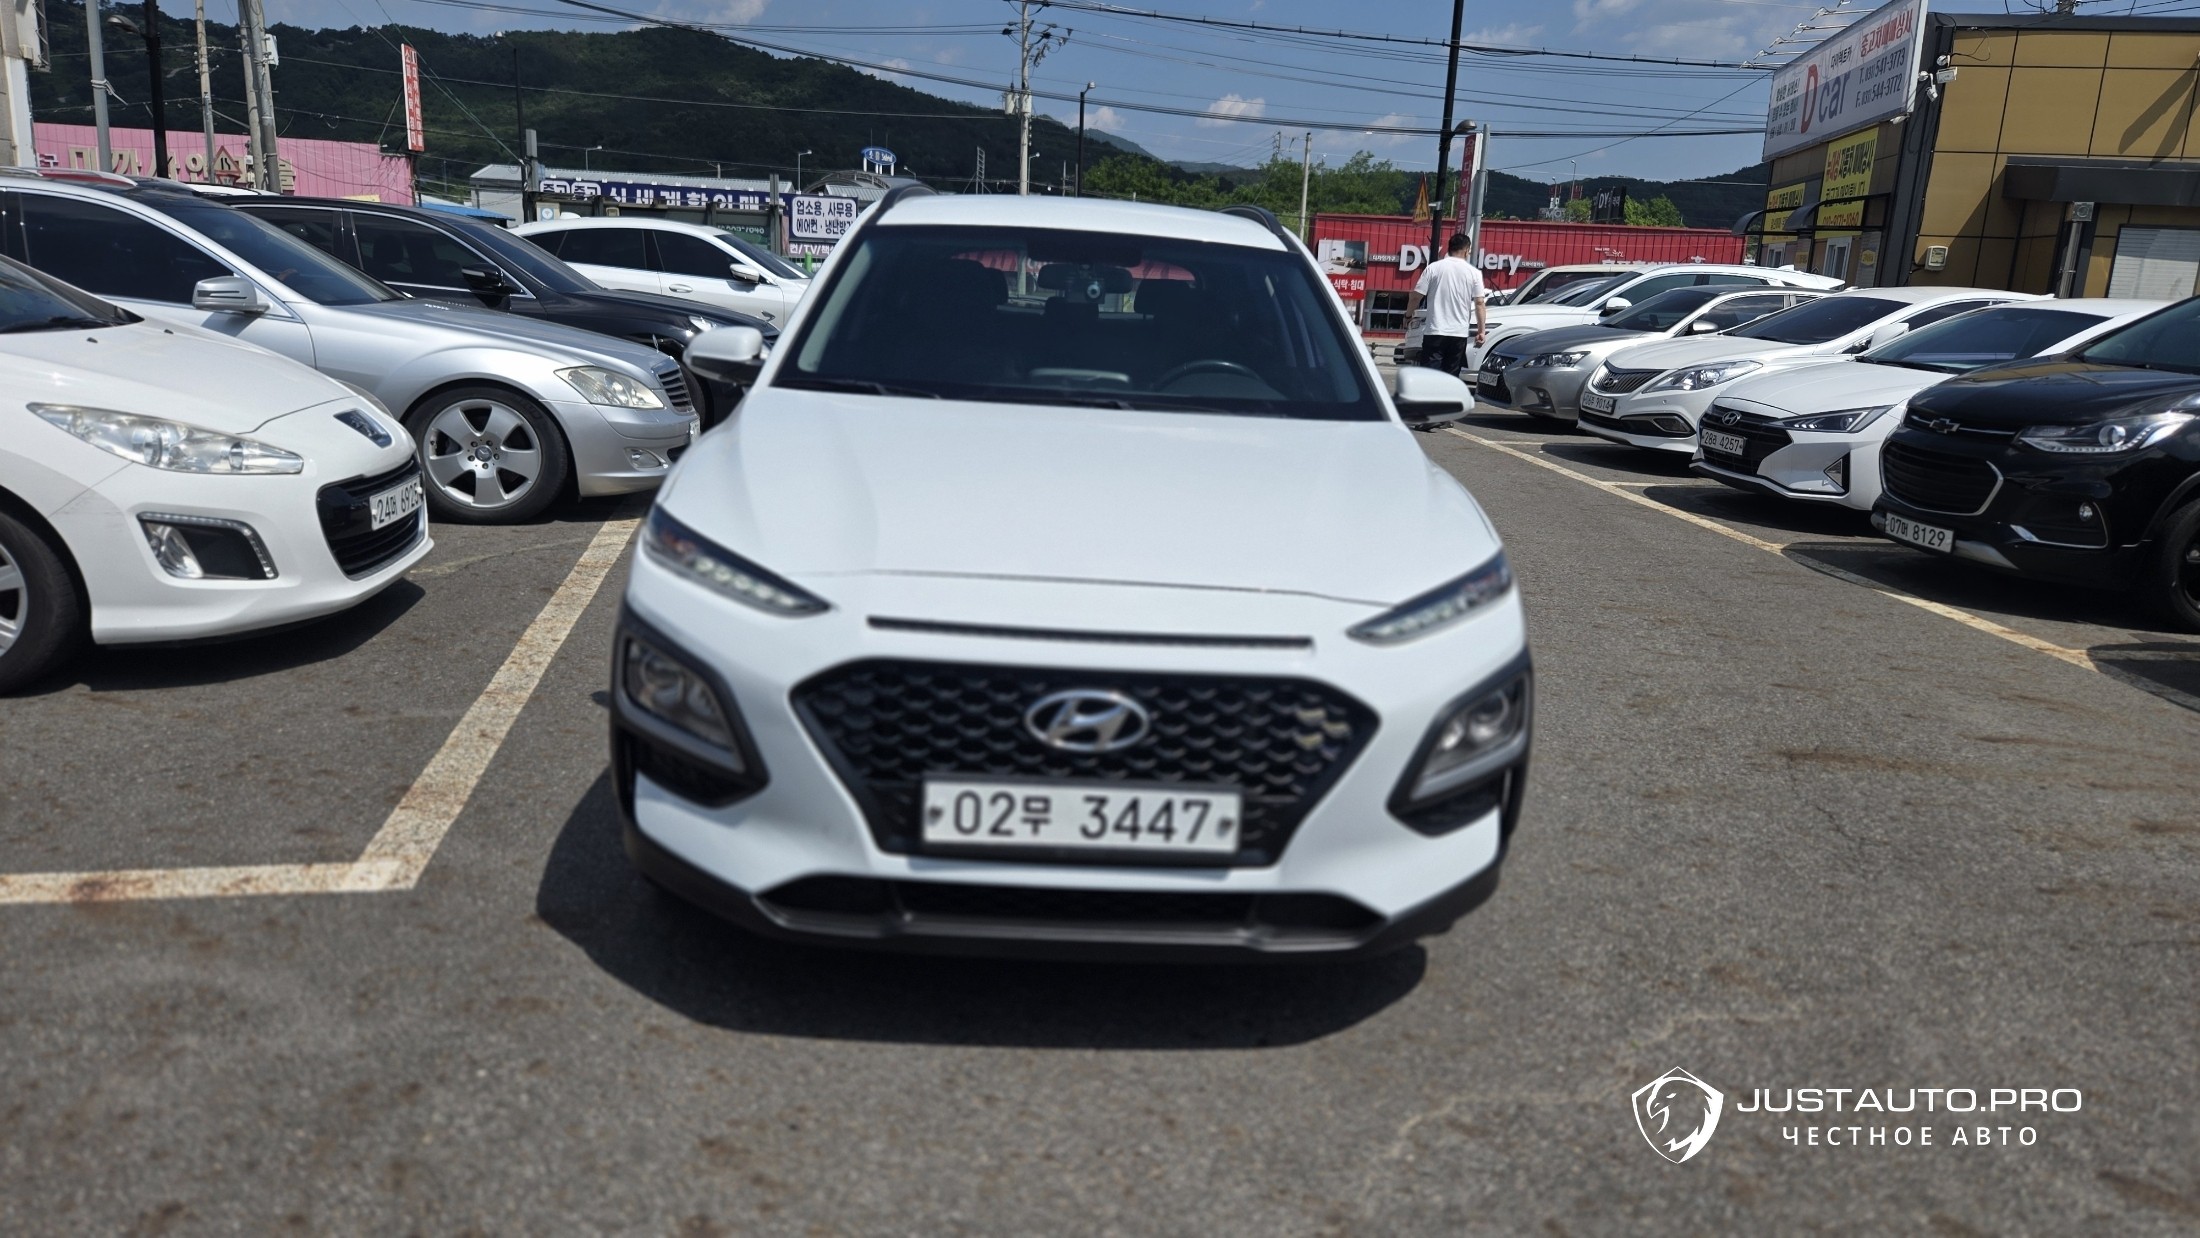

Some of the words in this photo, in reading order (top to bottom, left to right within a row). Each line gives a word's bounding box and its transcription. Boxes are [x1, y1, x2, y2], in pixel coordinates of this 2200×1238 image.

[1801, 64, 1818, 134] D
[1820, 71, 1851, 123] car
[796, 200, 824, 217] 업소용,
[828, 202, 853, 217] 사무용
[797, 219, 818, 233] 에어컨
[1720, 436, 1739, 451] 4257
[401, 482, 419, 512] 6925
[1912, 524, 1946, 547] 8129
[953, 789, 1053, 837] 02무
[1079, 795, 1212, 843] 3447
